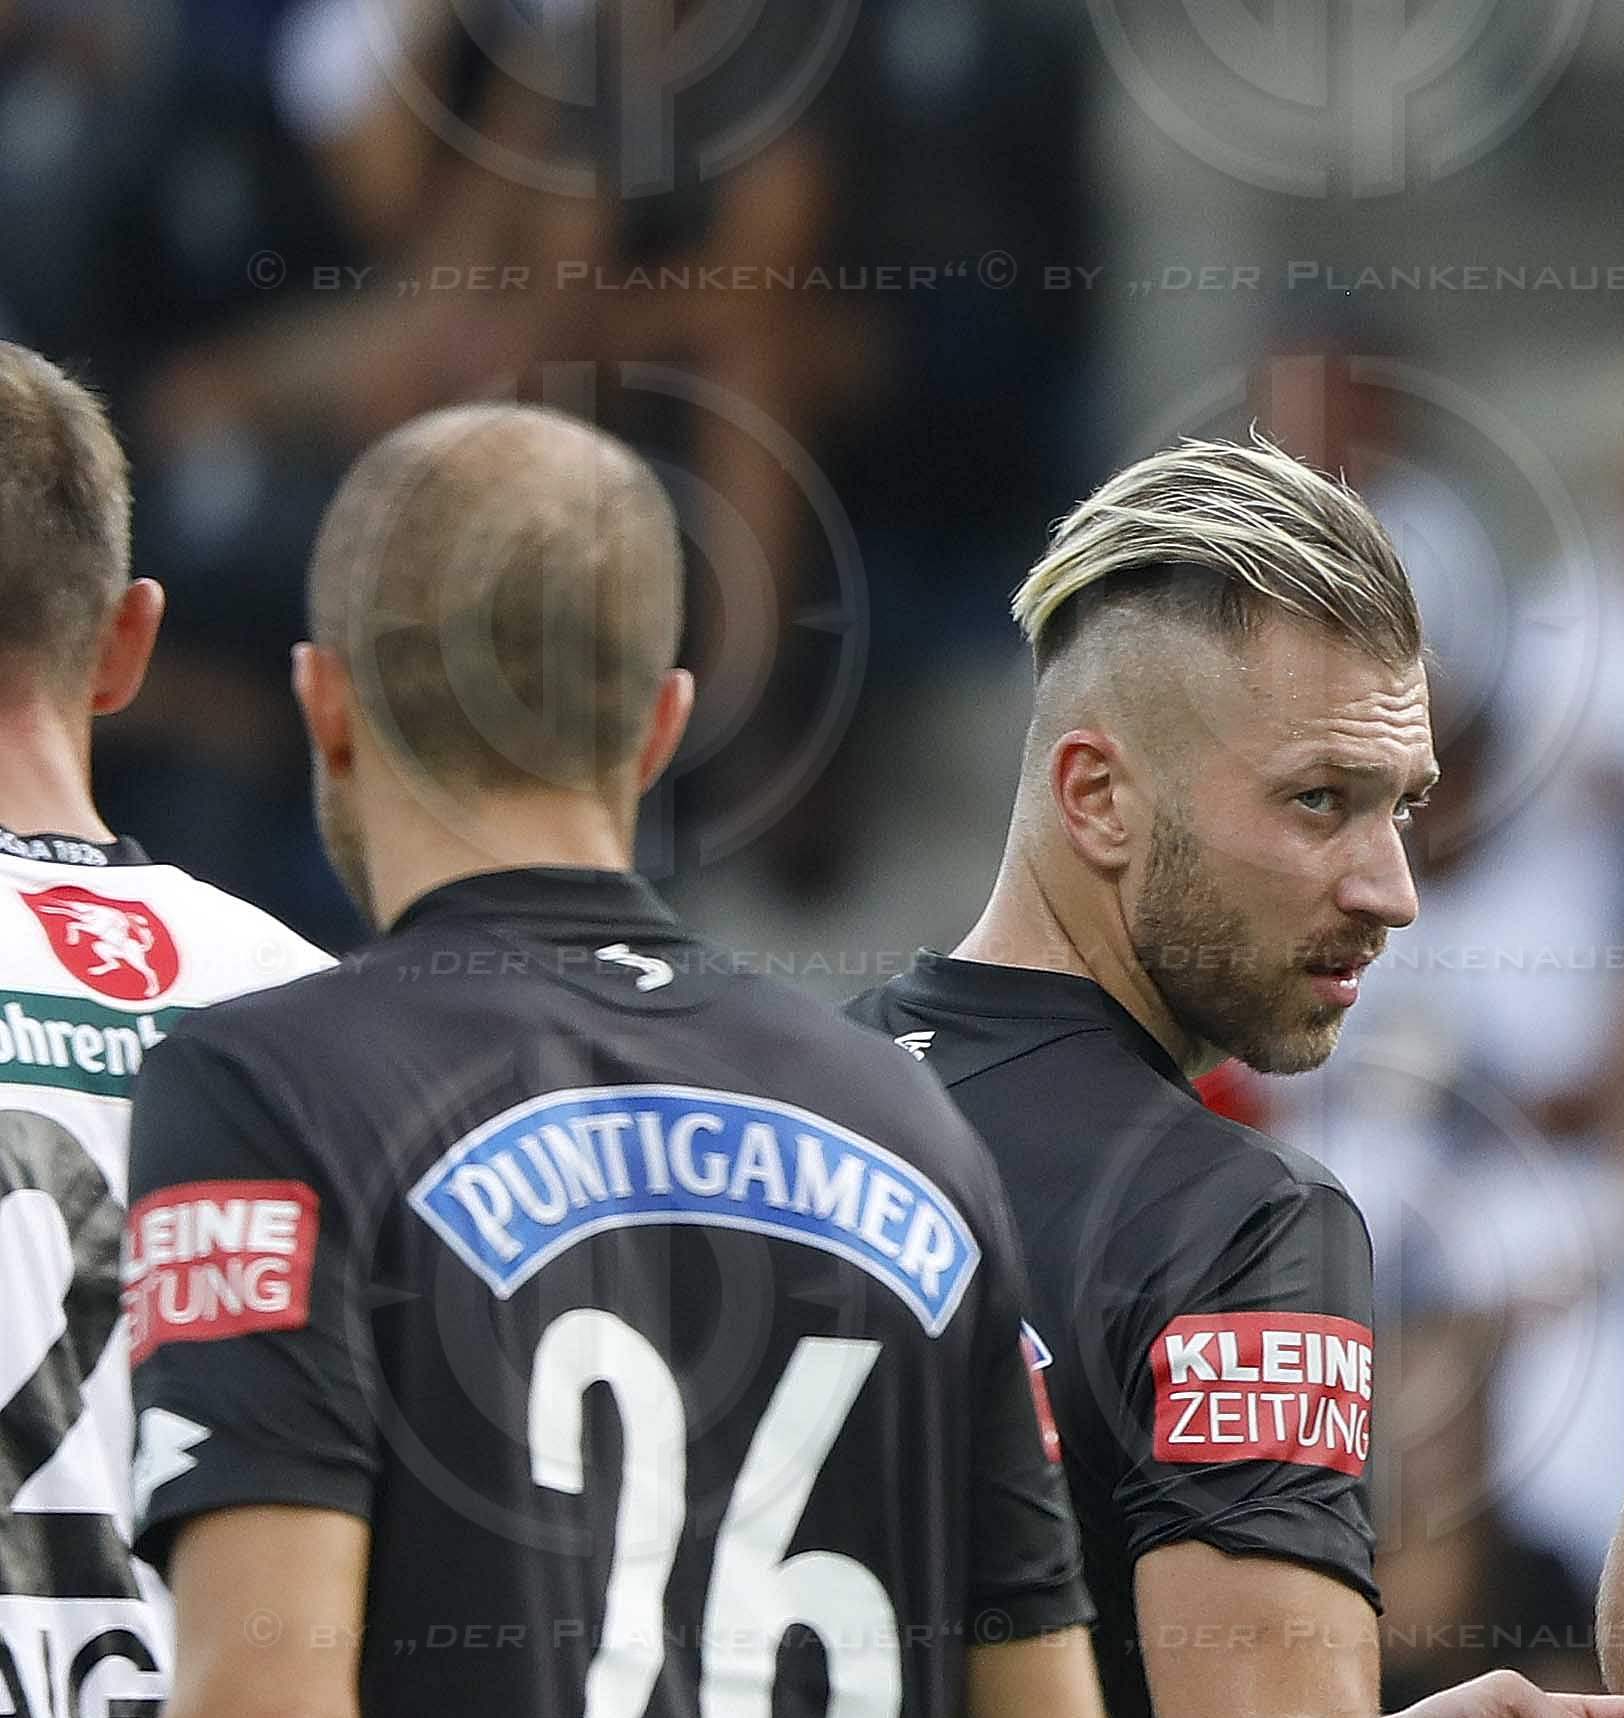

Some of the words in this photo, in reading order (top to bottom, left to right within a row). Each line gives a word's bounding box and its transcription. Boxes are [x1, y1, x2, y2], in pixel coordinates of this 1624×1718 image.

[448, 1110, 959, 1303] PUNTIGAMER
[1165, 1330, 1373, 1401] KLEINE
[1168, 1391, 1370, 1461] ZEITUNG
